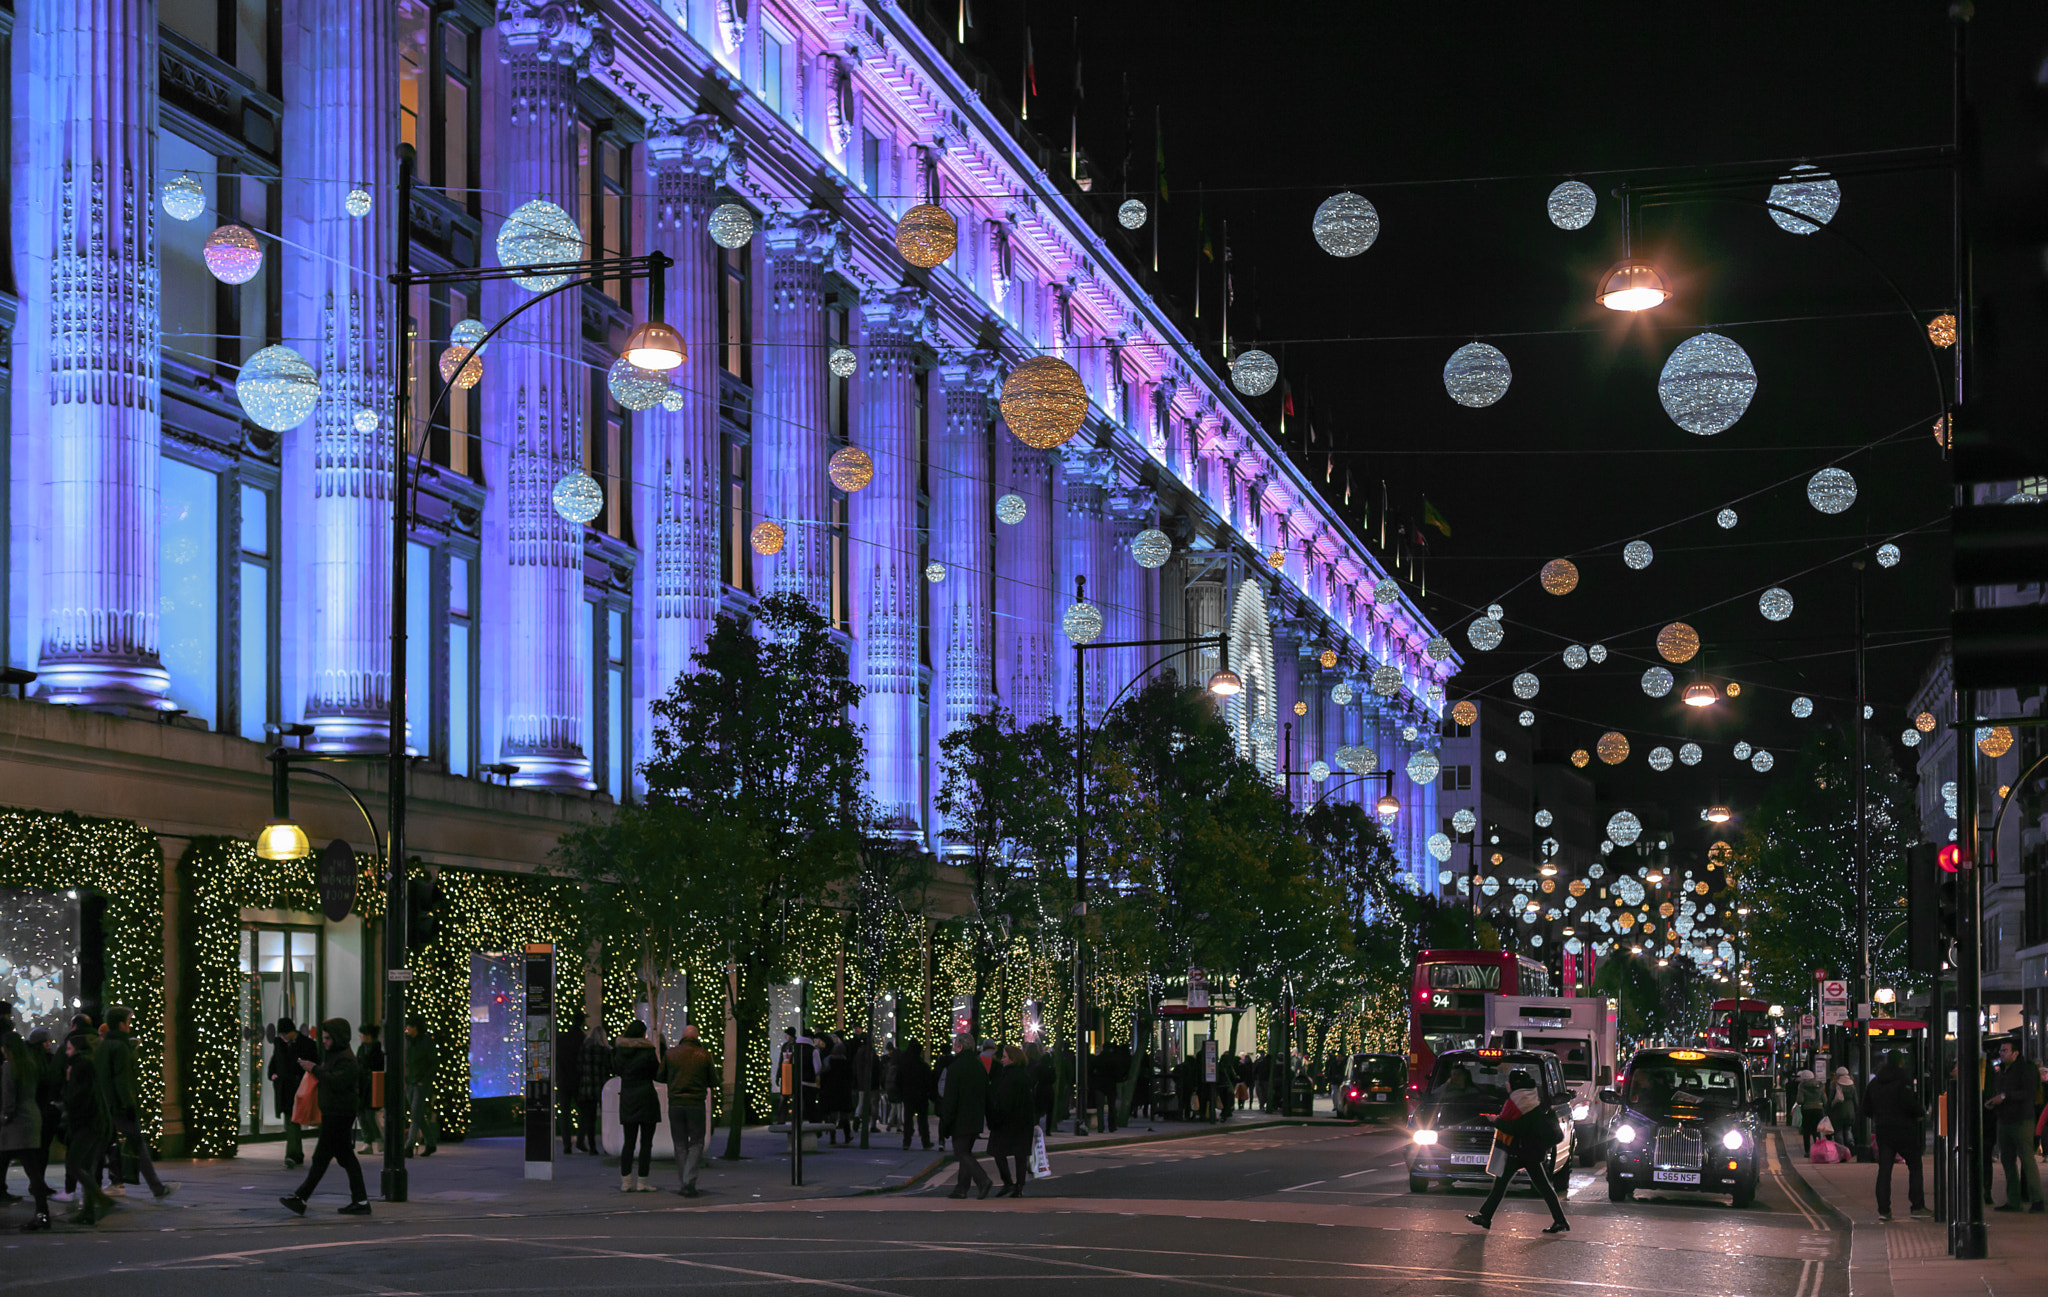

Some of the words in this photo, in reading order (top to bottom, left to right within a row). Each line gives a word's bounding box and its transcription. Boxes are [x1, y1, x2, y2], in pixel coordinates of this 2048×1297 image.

[1433, 994, 1450, 1008] 94
[1752, 1037, 1764, 1048] 73
[1657, 1171, 1679, 1181] LS65
[1680, 1173, 1697, 1182] NSF
